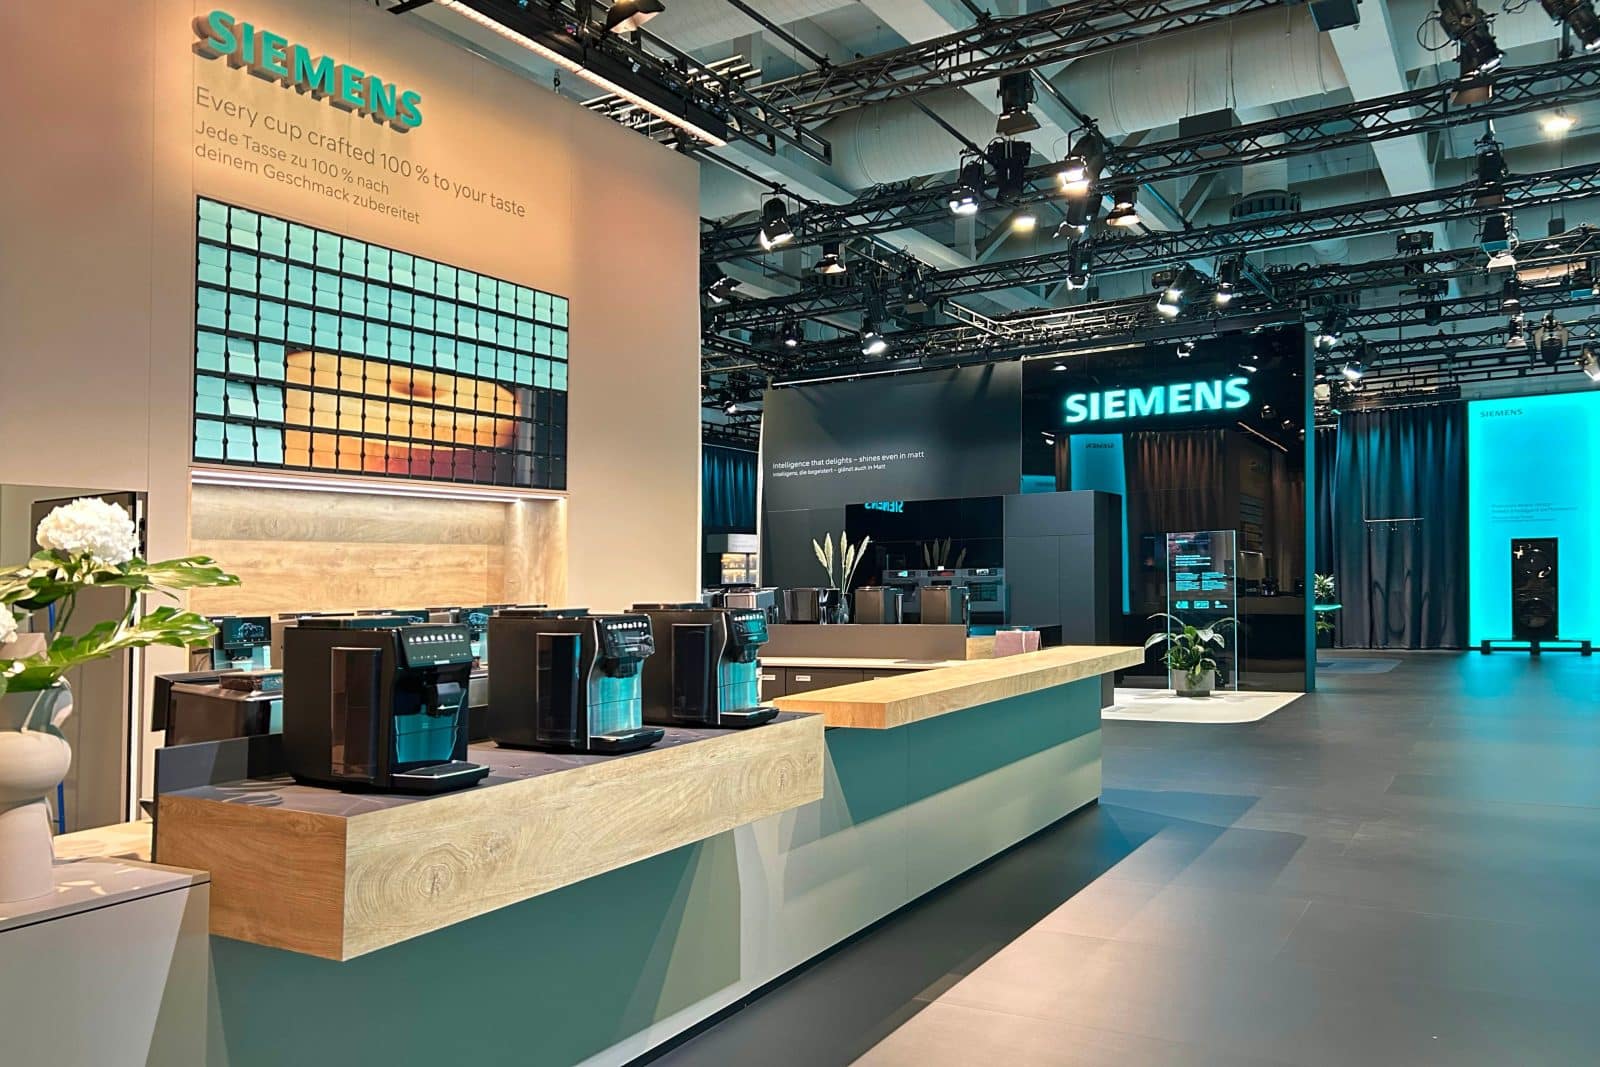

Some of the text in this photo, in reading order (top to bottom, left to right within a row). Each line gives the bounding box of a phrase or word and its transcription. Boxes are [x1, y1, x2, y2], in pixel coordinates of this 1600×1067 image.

[206, 10, 424, 128] SIEMENS
[195, 120, 389, 195] Jede Tasse zu 100 % nach
[195, 144, 420, 224] deinem Geschmack zubereitet
[196, 86, 526, 217] Every cup crafted 100 % to your taste
[1065, 377, 1251, 424] SIEMENS
[1479, 408, 1524, 418] SIEMENS
[772, 461, 810, 470] Intelligence
[825, 456, 852, 465] delights
[859, 455, 881, 463] shines
[899, 452, 907, 460] in
[907, 451, 925, 459] matt
